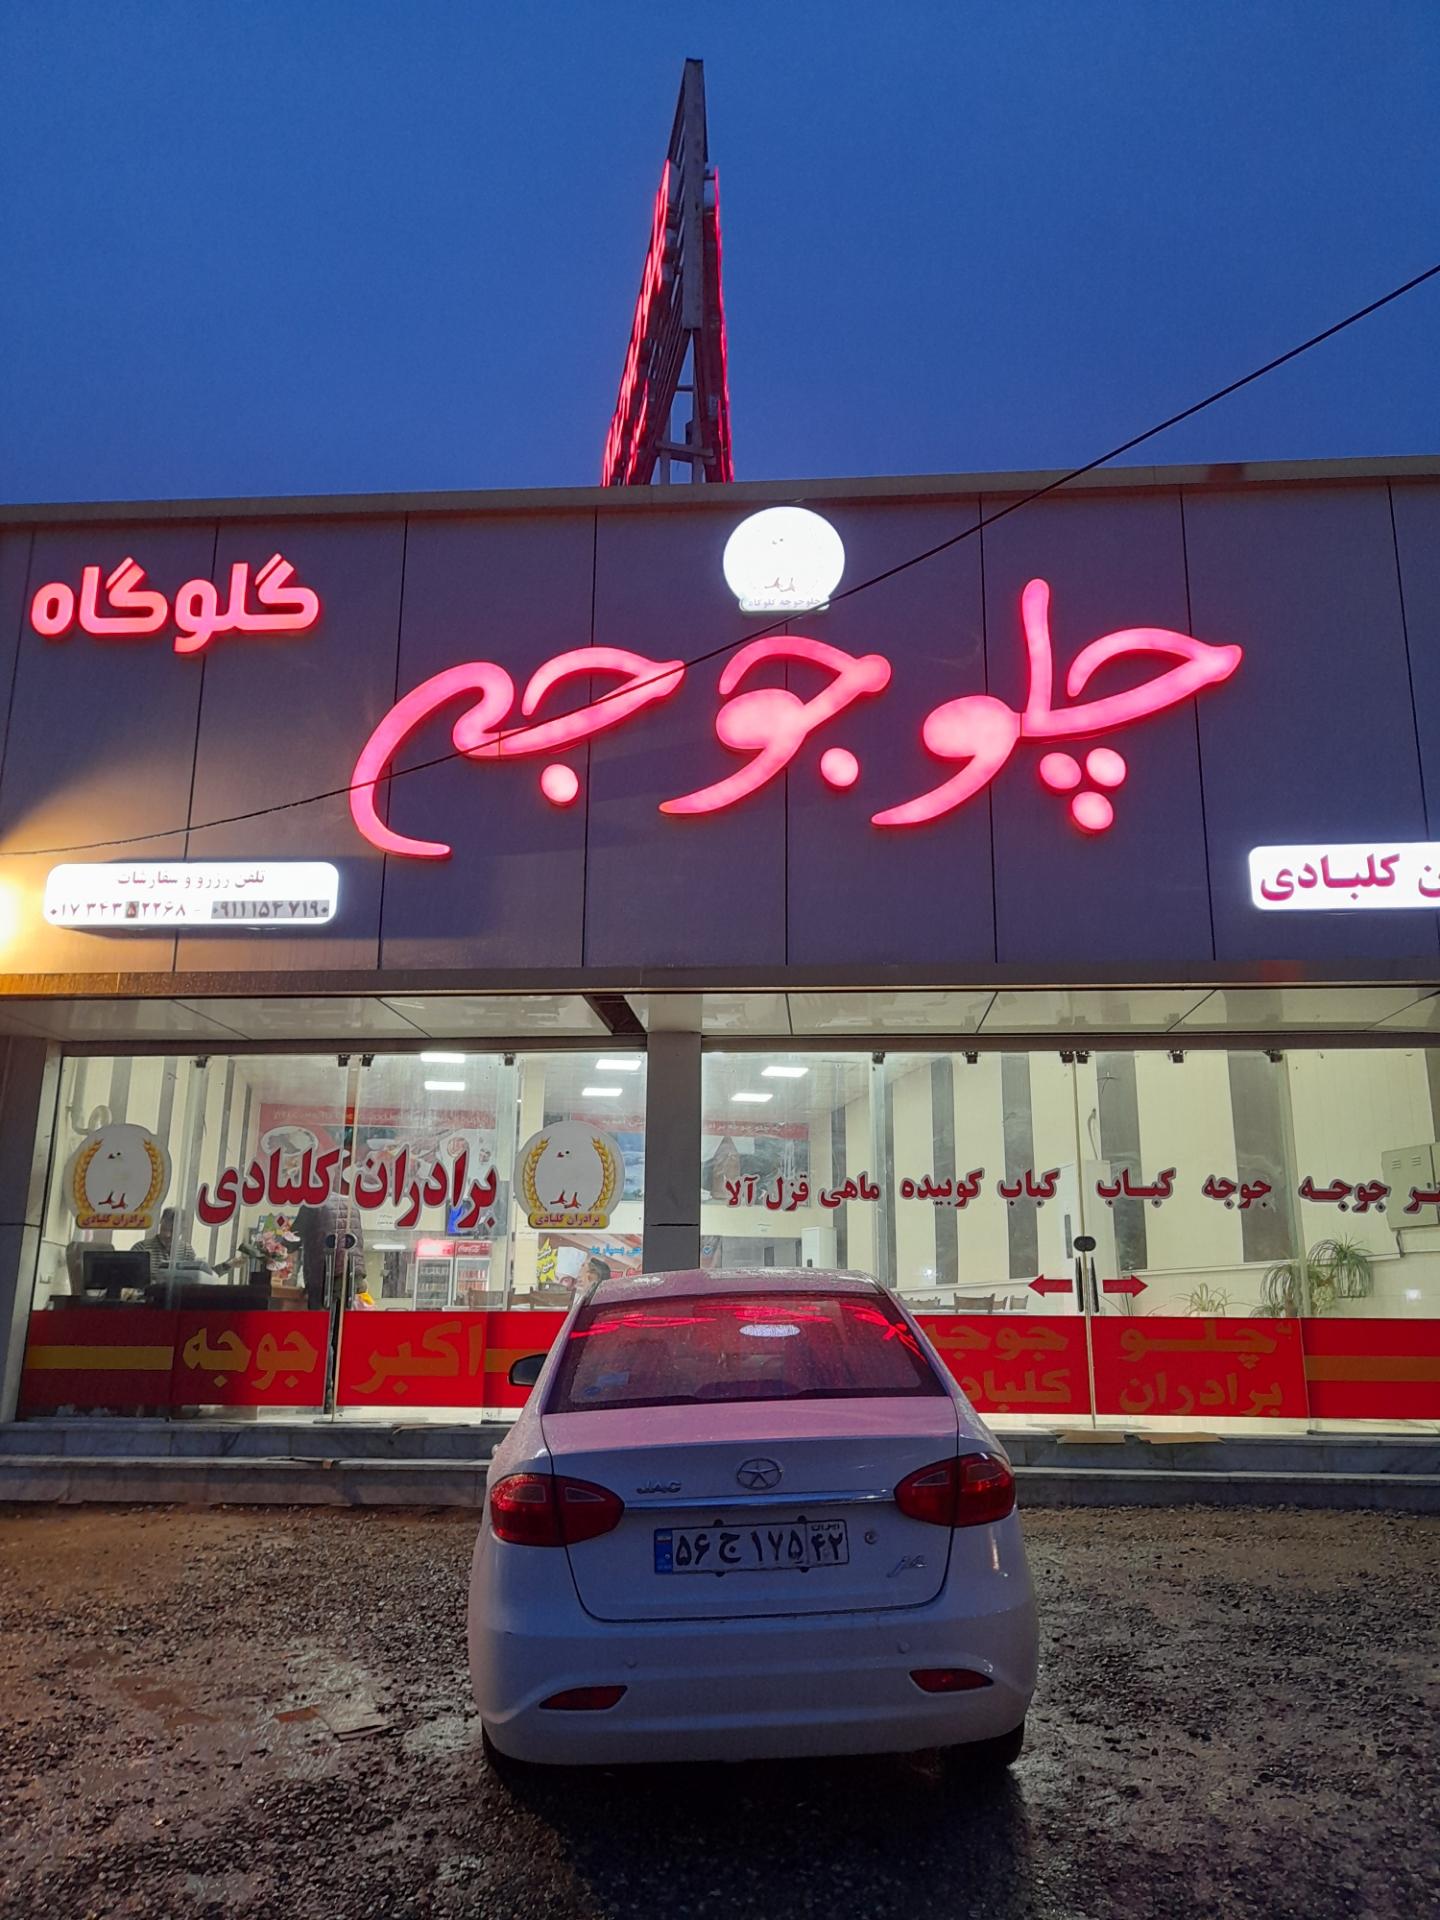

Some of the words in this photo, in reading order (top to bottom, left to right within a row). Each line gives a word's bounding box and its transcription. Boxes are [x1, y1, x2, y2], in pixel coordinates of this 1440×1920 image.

[31, 552, 320, 654] گلوگاه
[872, 579, 1242, 832] چلو
[350, 636, 891, 858] جوجه
[118, 870, 178, 888] سفارشات
[184, 873, 191, 888] و
[197, 873, 230, 888] رزرو
[234, 869, 265, 888] تلفن
[1260, 853, 1400, 902] کلبادی
[196, 1146, 341, 1228] کلبادی
[354, 1147, 497, 1229] برادران
[725, 1175, 758, 1206] آلا
[765, 1174, 810, 1212] قزل
[820, 1173, 880, 1208] ماهی
[900, 1168, 984, 1208] کوبیده
[998, 1168, 1061, 1207] کباب
[1096, 1167, 1177, 1207] کباب
[1202, 1174, 1272, 1210] جوجه
[1300, 1175, 1391, 1213] جوجه
[535, 1213, 564, 1227] کلبادی
[567, 1213, 600, 1227] برادران
[182, 1327, 319, 1391] جوجه
[350, 1320, 484, 1394] اکبر
[1116, 1318, 1278, 1370] چلو
[961, 1367, 1072, 1411] کلباد
[1118, 1372, 1285, 1417] برادران
[636, 1480, 682, 1494] JAC
